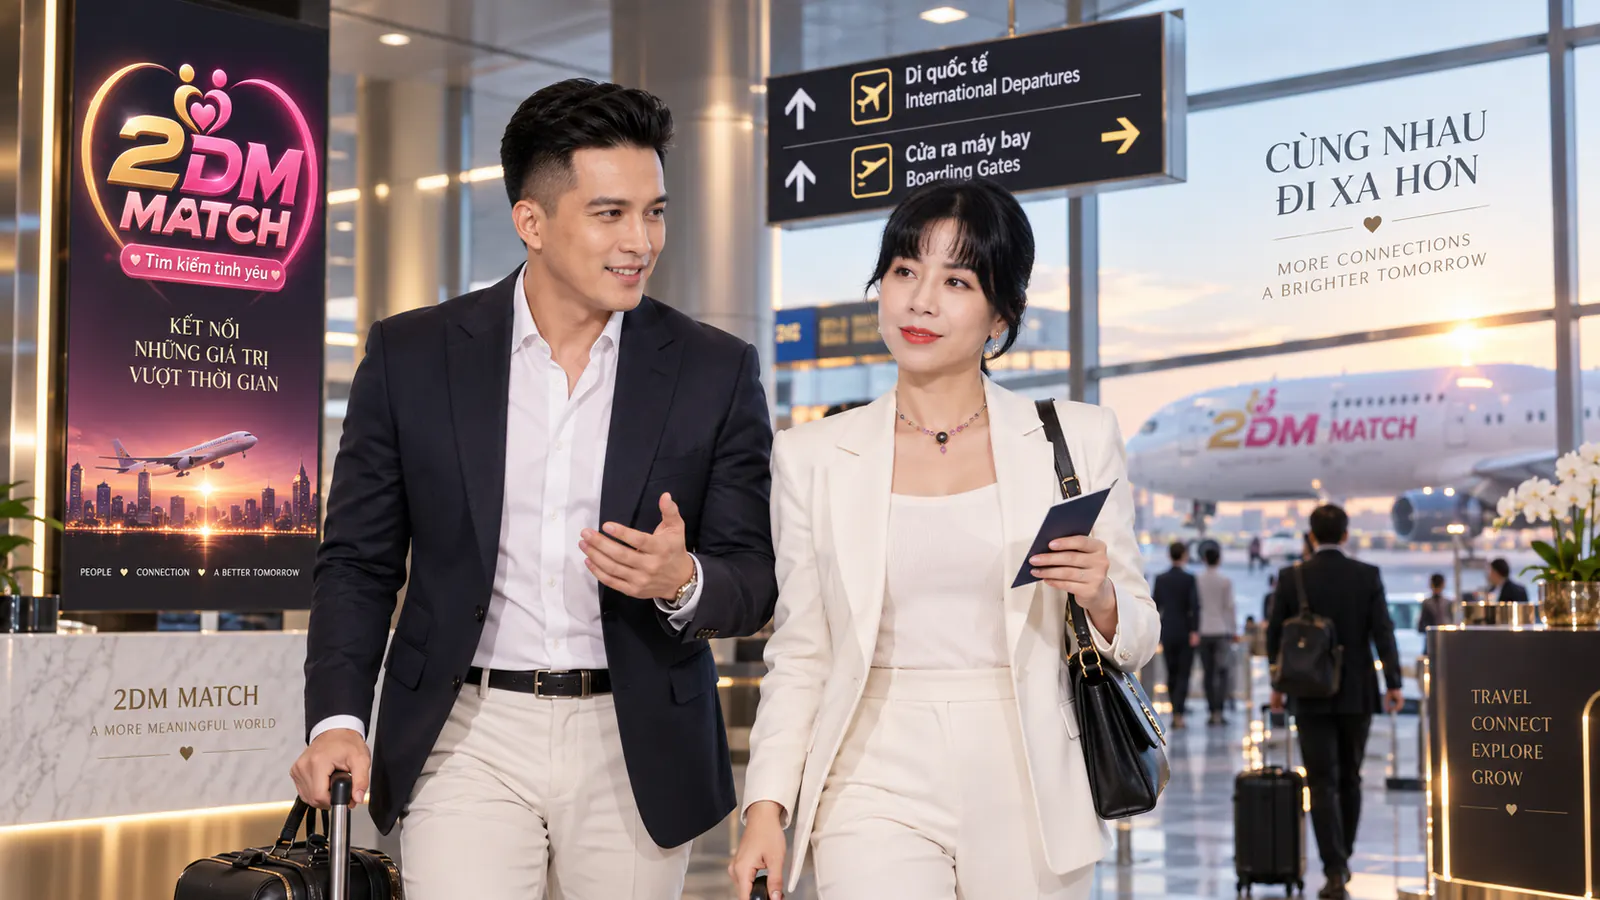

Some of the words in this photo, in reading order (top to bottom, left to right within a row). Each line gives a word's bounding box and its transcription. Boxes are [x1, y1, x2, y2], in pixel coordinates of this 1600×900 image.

[905, 65, 922, 84] Di
[926, 56, 967, 84] quốc
[971, 51, 989, 73] tế
[905, 78, 997, 109] International
[1001, 69, 1081, 95] Departures
[905, 141, 936, 163] Cửa
[941, 142, 957, 157] ra
[962, 133, 996, 156] máy
[1001, 130, 1031, 150] bay
[1265, 131, 1369, 173] CÙNG
[1383, 110, 1487, 156] NHAU
[107, 114, 304, 206] 2DM
[906, 164, 973, 188] Boarding
[977, 158, 1021, 177] Gates
[1276, 181, 1315, 216] ĐI
[1330, 172, 1381, 208] XA
[1395, 154, 1478, 197] HƠN
[119, 191, 291, 247] MATCH
[177, 256, 210, 274] kiếm
[245, 265, 268, 281] yêu
[1277, 255, 1329, 276] MORE
[1337, 233, 1471, 266] CONNECTIONS
[1262, 286, 1273, 300] A
[1281, 271, 1369, 297] BRIGHTER
[1377, 252, 1487, 282] TOMORROW
[170, 313, 203, 336] KẾT
[209, 317, 239, 339] NỐI
[135, 339, 200, 361] NHỮNG
[206, 344, 236, 364] GIÁ
[242, 348, 268, 370] TRỊ
[129, 366, 182, 388] VƯỢT
[188, 368, 231, 389] THỜI
[237, 373, 278, 392] GIAN
[1207, 410, 1320, 450] 2DM
[1329, 415, 1417, 443] MATCH
[80, 567, 112, 577] PEOPLE
[136, 567, 190, 577] CONNECTION
[213, 568, 220, 577] A
[222, 568, 250, 577] BETTER
[252, 568, 300, 577] TOMORROW
[113, 687, 168, 711] 2DM
[178, 685, 258, 708] MATCH
[1471, 689, 1532, 705] TRAVEL
[90, 725, 99, 737] A
[104, 723, 142, 736] MORE
[147, 720, 229, 734] MEANINGFUL
[233, 717, 276, 730] WORLD
[1471, 716, 1552, 732] CONNECT
[1472, 742, 1544, 760] EXPLORE
[1472, 769, 1523, 786] GROW
